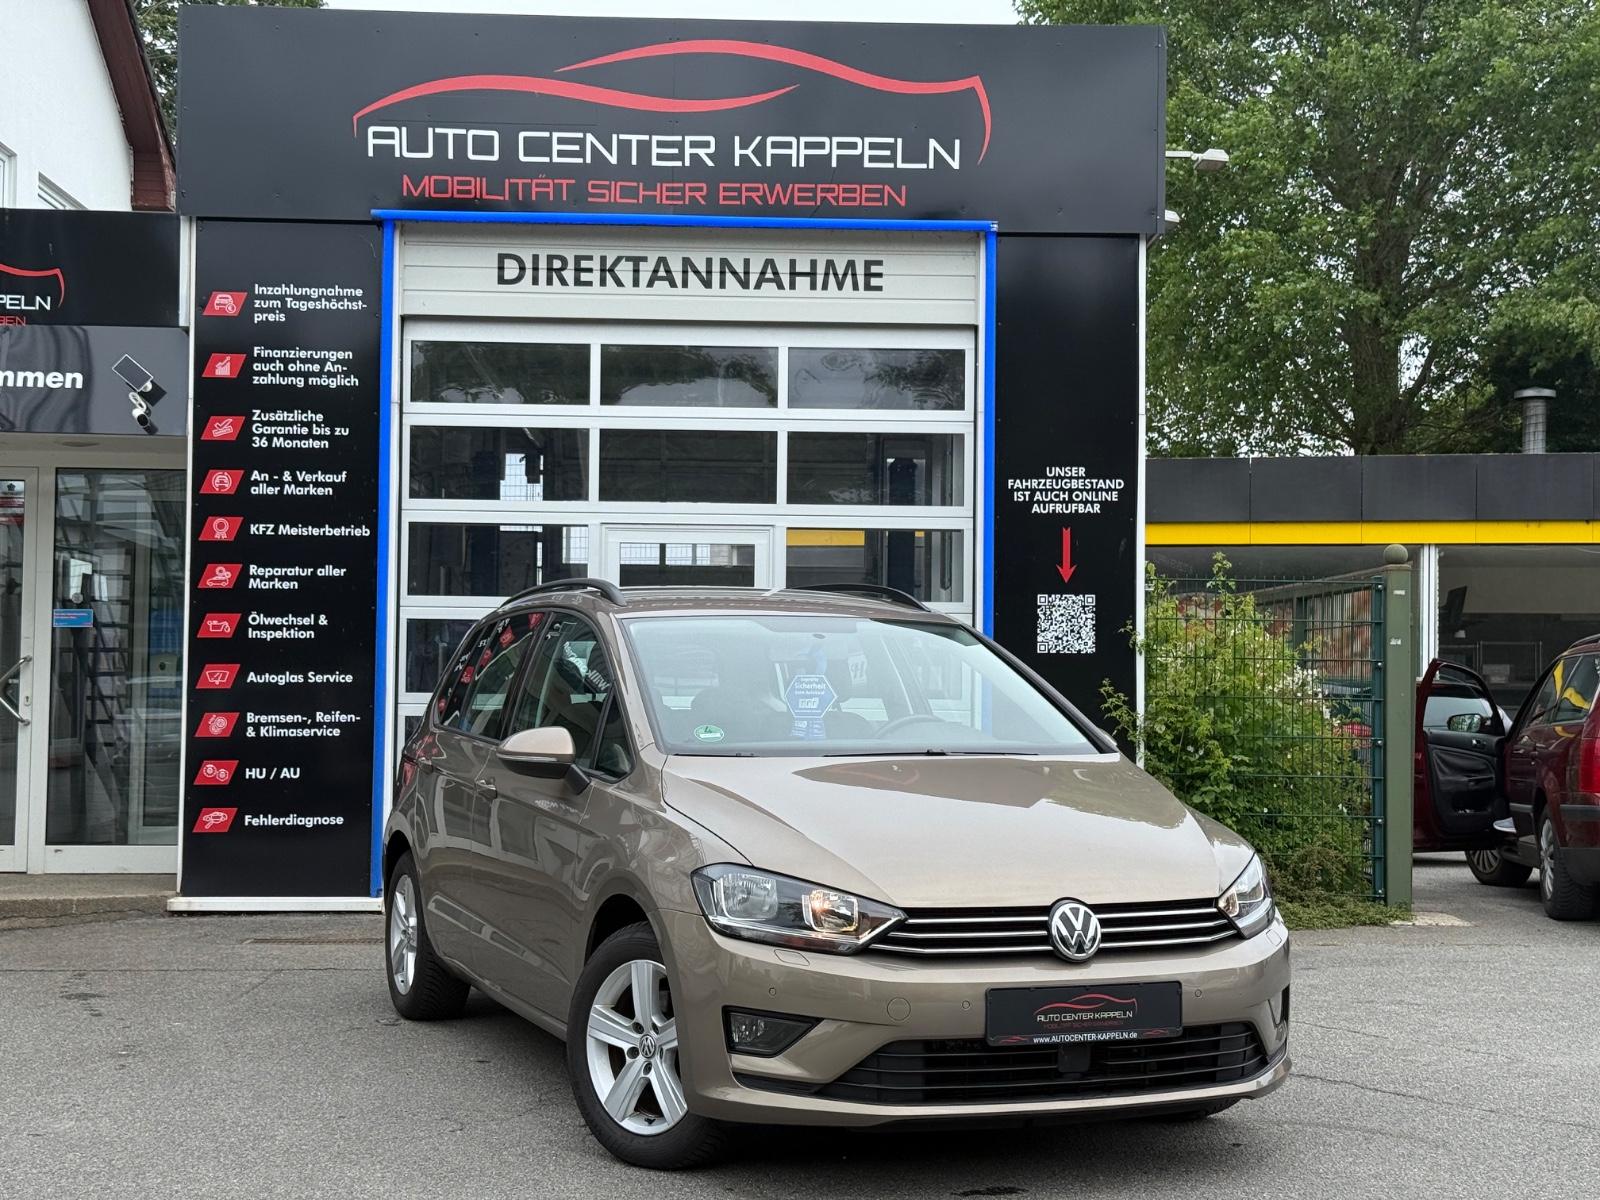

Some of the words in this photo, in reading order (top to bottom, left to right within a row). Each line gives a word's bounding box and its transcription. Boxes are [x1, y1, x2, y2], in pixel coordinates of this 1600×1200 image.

[367, 126, 500, 161] AUTO
[518, 131, 716, 167] CENTER
[734, 135, 960, 170] KAPPELN
[402, 173, 576, 201] MOBILITÄT
[587, 180, 707, 205] SICHER
[719, 182, 907, 207] ERWERBEN
[496, 253, 884, 293] DIREKTANNAHME
[254, 283, 363, 298] Inzahlungnahme
[253, 299, 282, 309] zum
[285, 297, 368, 312] Tageshöchst-
[253, 310, 286, 324] preis
[253, 346, 353, 361] Finanzierungen
[252, 360, 284, 371] auch
[287, 360, 321, 372] ohne
[323, 361, 348, 373] An-
[252, 373, 305, 388] zahlung
[308, 374, 359, 389] möglich
[251, 409, 324, 422] Zusätzliche
[251, 423, 309, 435] Garantie
[312, 423, 331, 436] bis
[334, 427, 350, 436] zu
[251, 436, 268, 448] 36
[271, 436, 329, 449] Monaten
[250, 470, 269, 482] An
[282, 470, 293, 482] &
[295, 470, 348, 483] Verkauf
[1046, 466, 1086, 477] UNSER
[250, 483, 281, 495] aller
[283, 483, 333, 496] Marken
[1007, 478, 1125, 490] FAHRZEUGBESTAND
[1013, 491, 1031, 502] IST
[1033, 491, 1069, 502] AUCH
[1072, 491, 1119, 502] ONLINE
[1031, 503, 1101, 514] AUFRUFBAR
[249, 523, 276, 536] KFZ
[277, 523, 371, 537] Meisterbetrieb
[248, 564, 314, 579] Reparatur
[316, 564, 347, 577] aller
[248, 577, 299, 590] Marken
[247, 610, 315, 626] Ölwechsel
[318, 613, 329, 626] &
[247, 626, 315, 642] Inspektion
[246, 670, 305, 686] Autoglas
[307, 670, 354, 684] Service
[246, 711, 312, 725] Bremsen-,
[315, 710, 361, 723] Reifen-
[245, 726, 256, 738] &
[259, 725, 341, 738] Klimaservice
[245, 767, 267, 780] HU
[269, 767, 278, 780] /
[279, 767, 301, 779] AU
[244, 813, 345, 828] Fehlerdiagnose
[1036, 1014, 1060, 1022] AUTO
[1061, 1012, 1094, 1021] CENTER
[1094, 1010, 1133, 1019] KAPPELN
[1033, 1031, 1138, 1044] www.AUTOCENTER-KAPPELN.de
